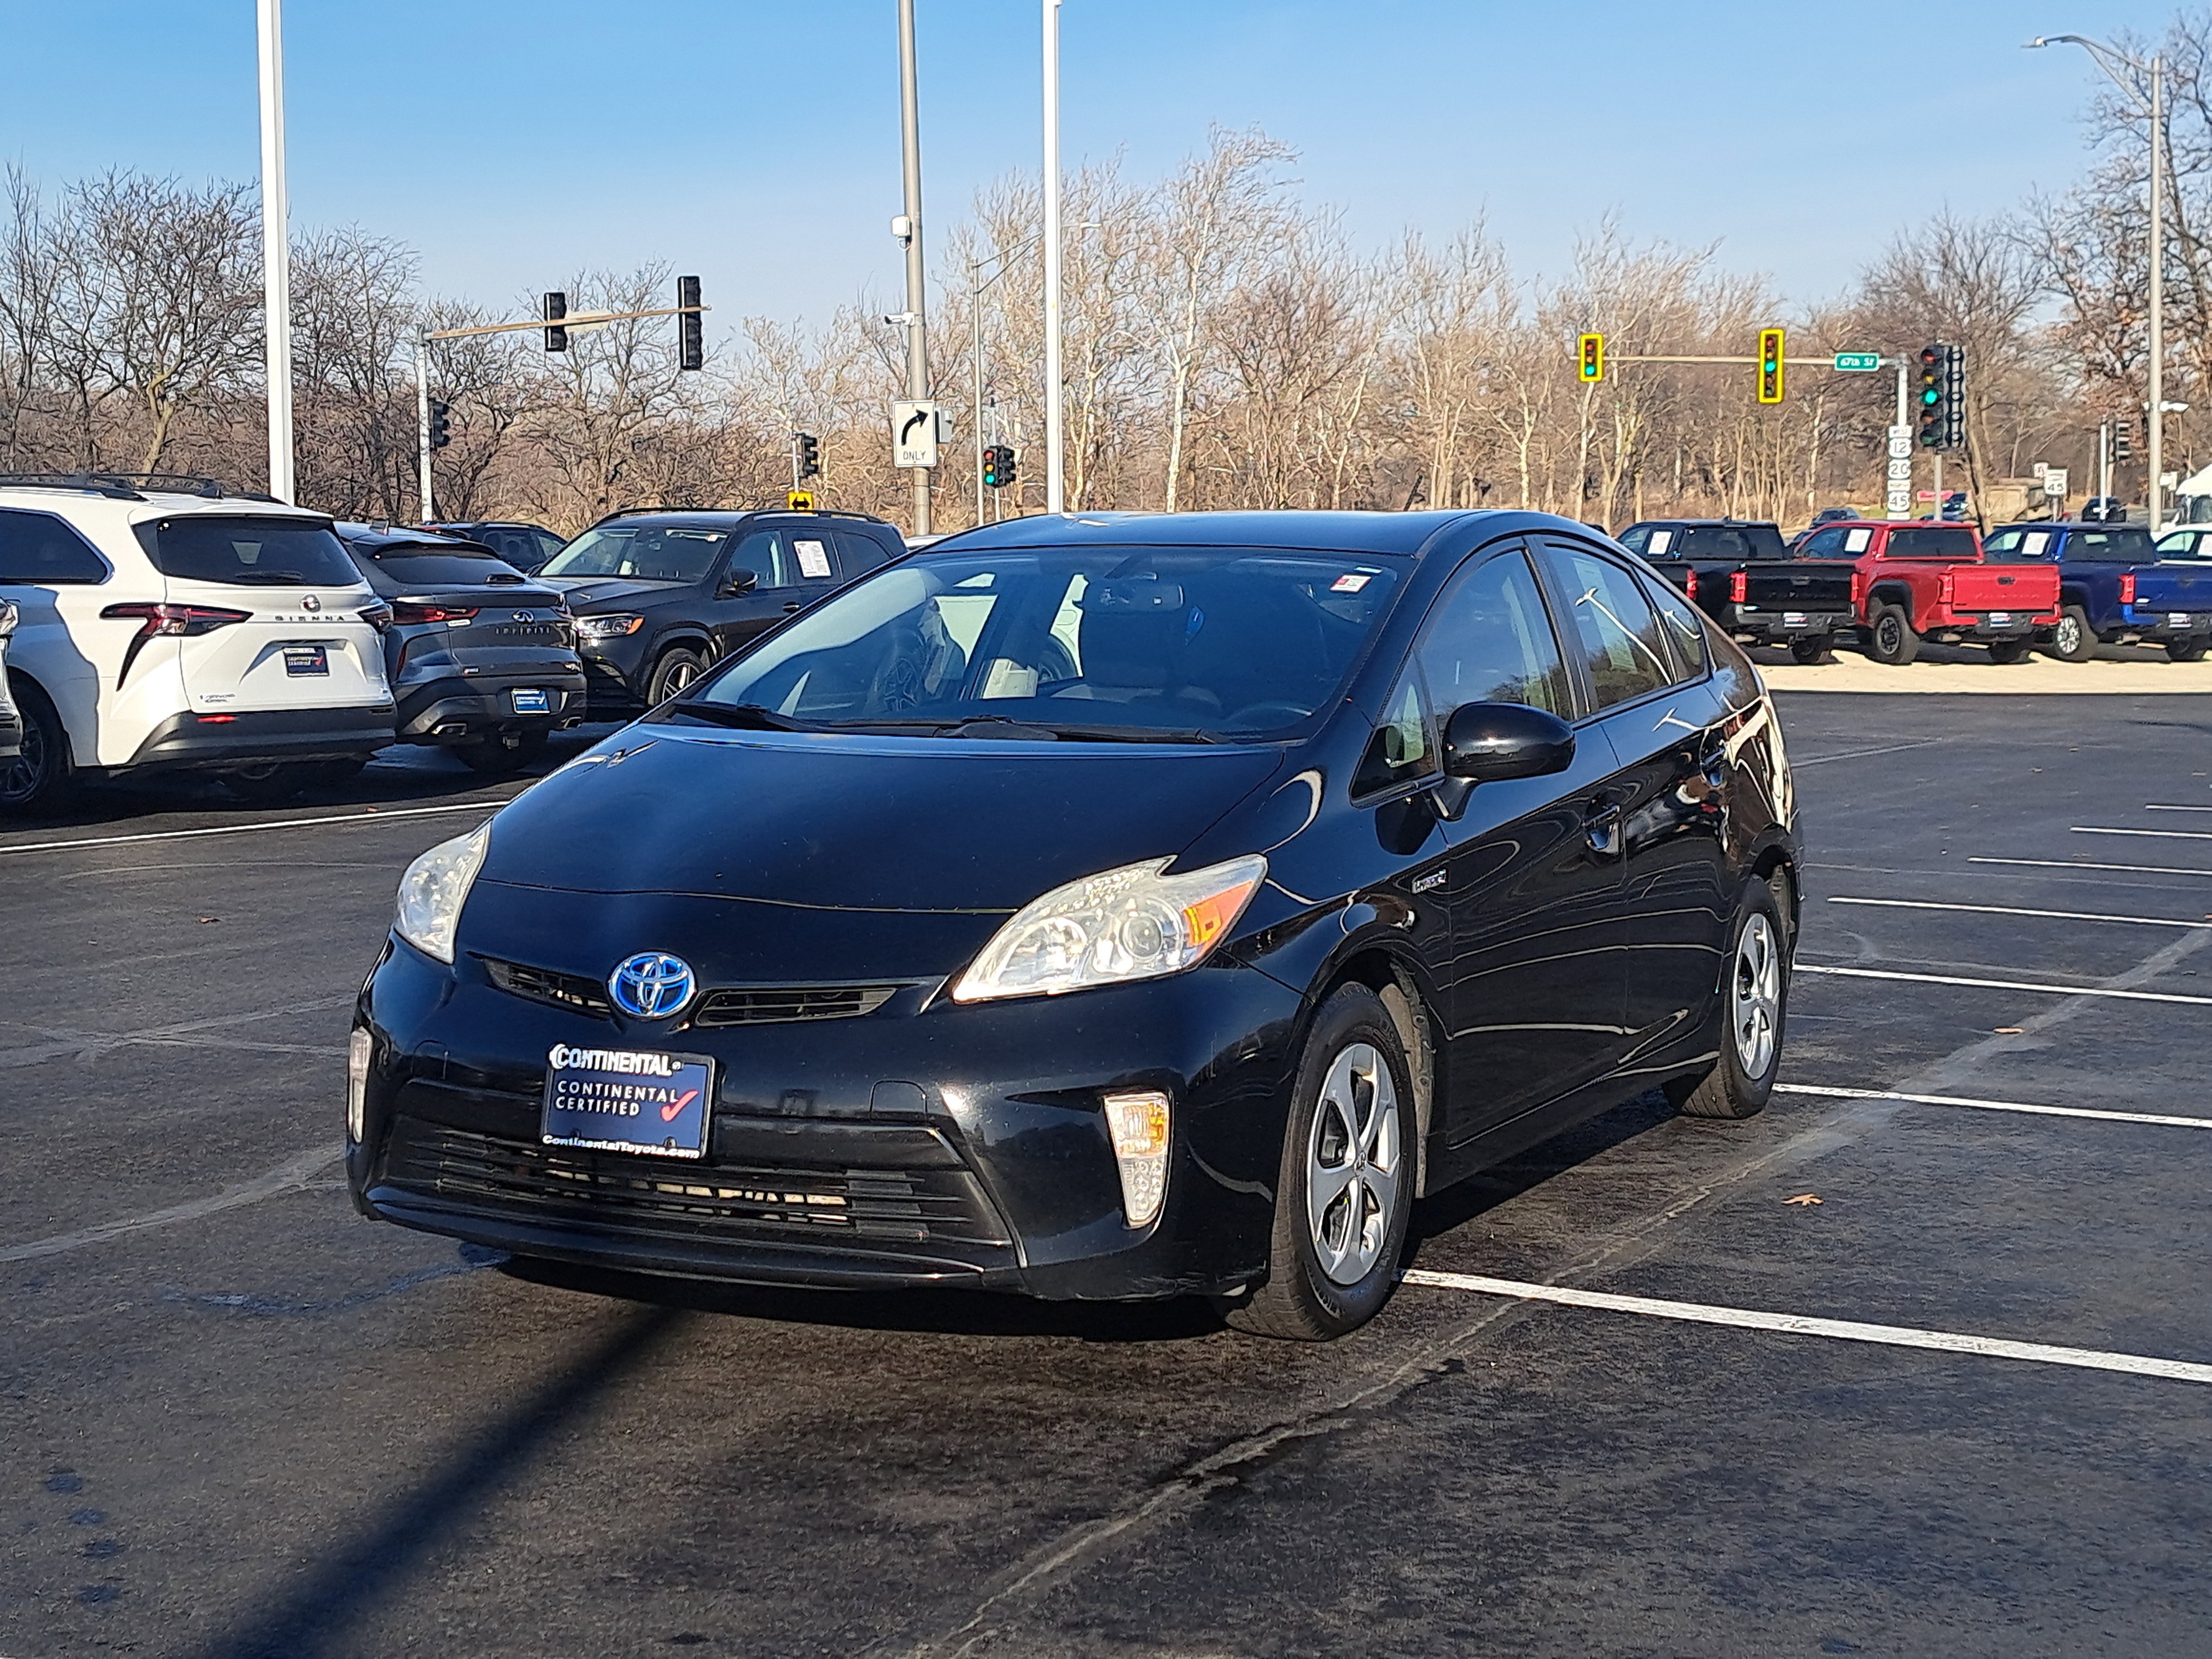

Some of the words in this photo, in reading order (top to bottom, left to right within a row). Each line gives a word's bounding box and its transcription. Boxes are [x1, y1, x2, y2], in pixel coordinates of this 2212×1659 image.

[1894, 442, 1907, 453] 12
[903, 451, 926, 461] ONLY
[1891, 463, 1908, 475] 20
[1890, 495, 1907, 507] 45
[550, 1044, 673, 1076] CONTINENTAL
[557, 1080, 679, 1103] CONTINENTAL
[555, 1096, 640, 1116] CERTIFIED
[542, 1134, 700, 1159] ContinentalToyota.com
